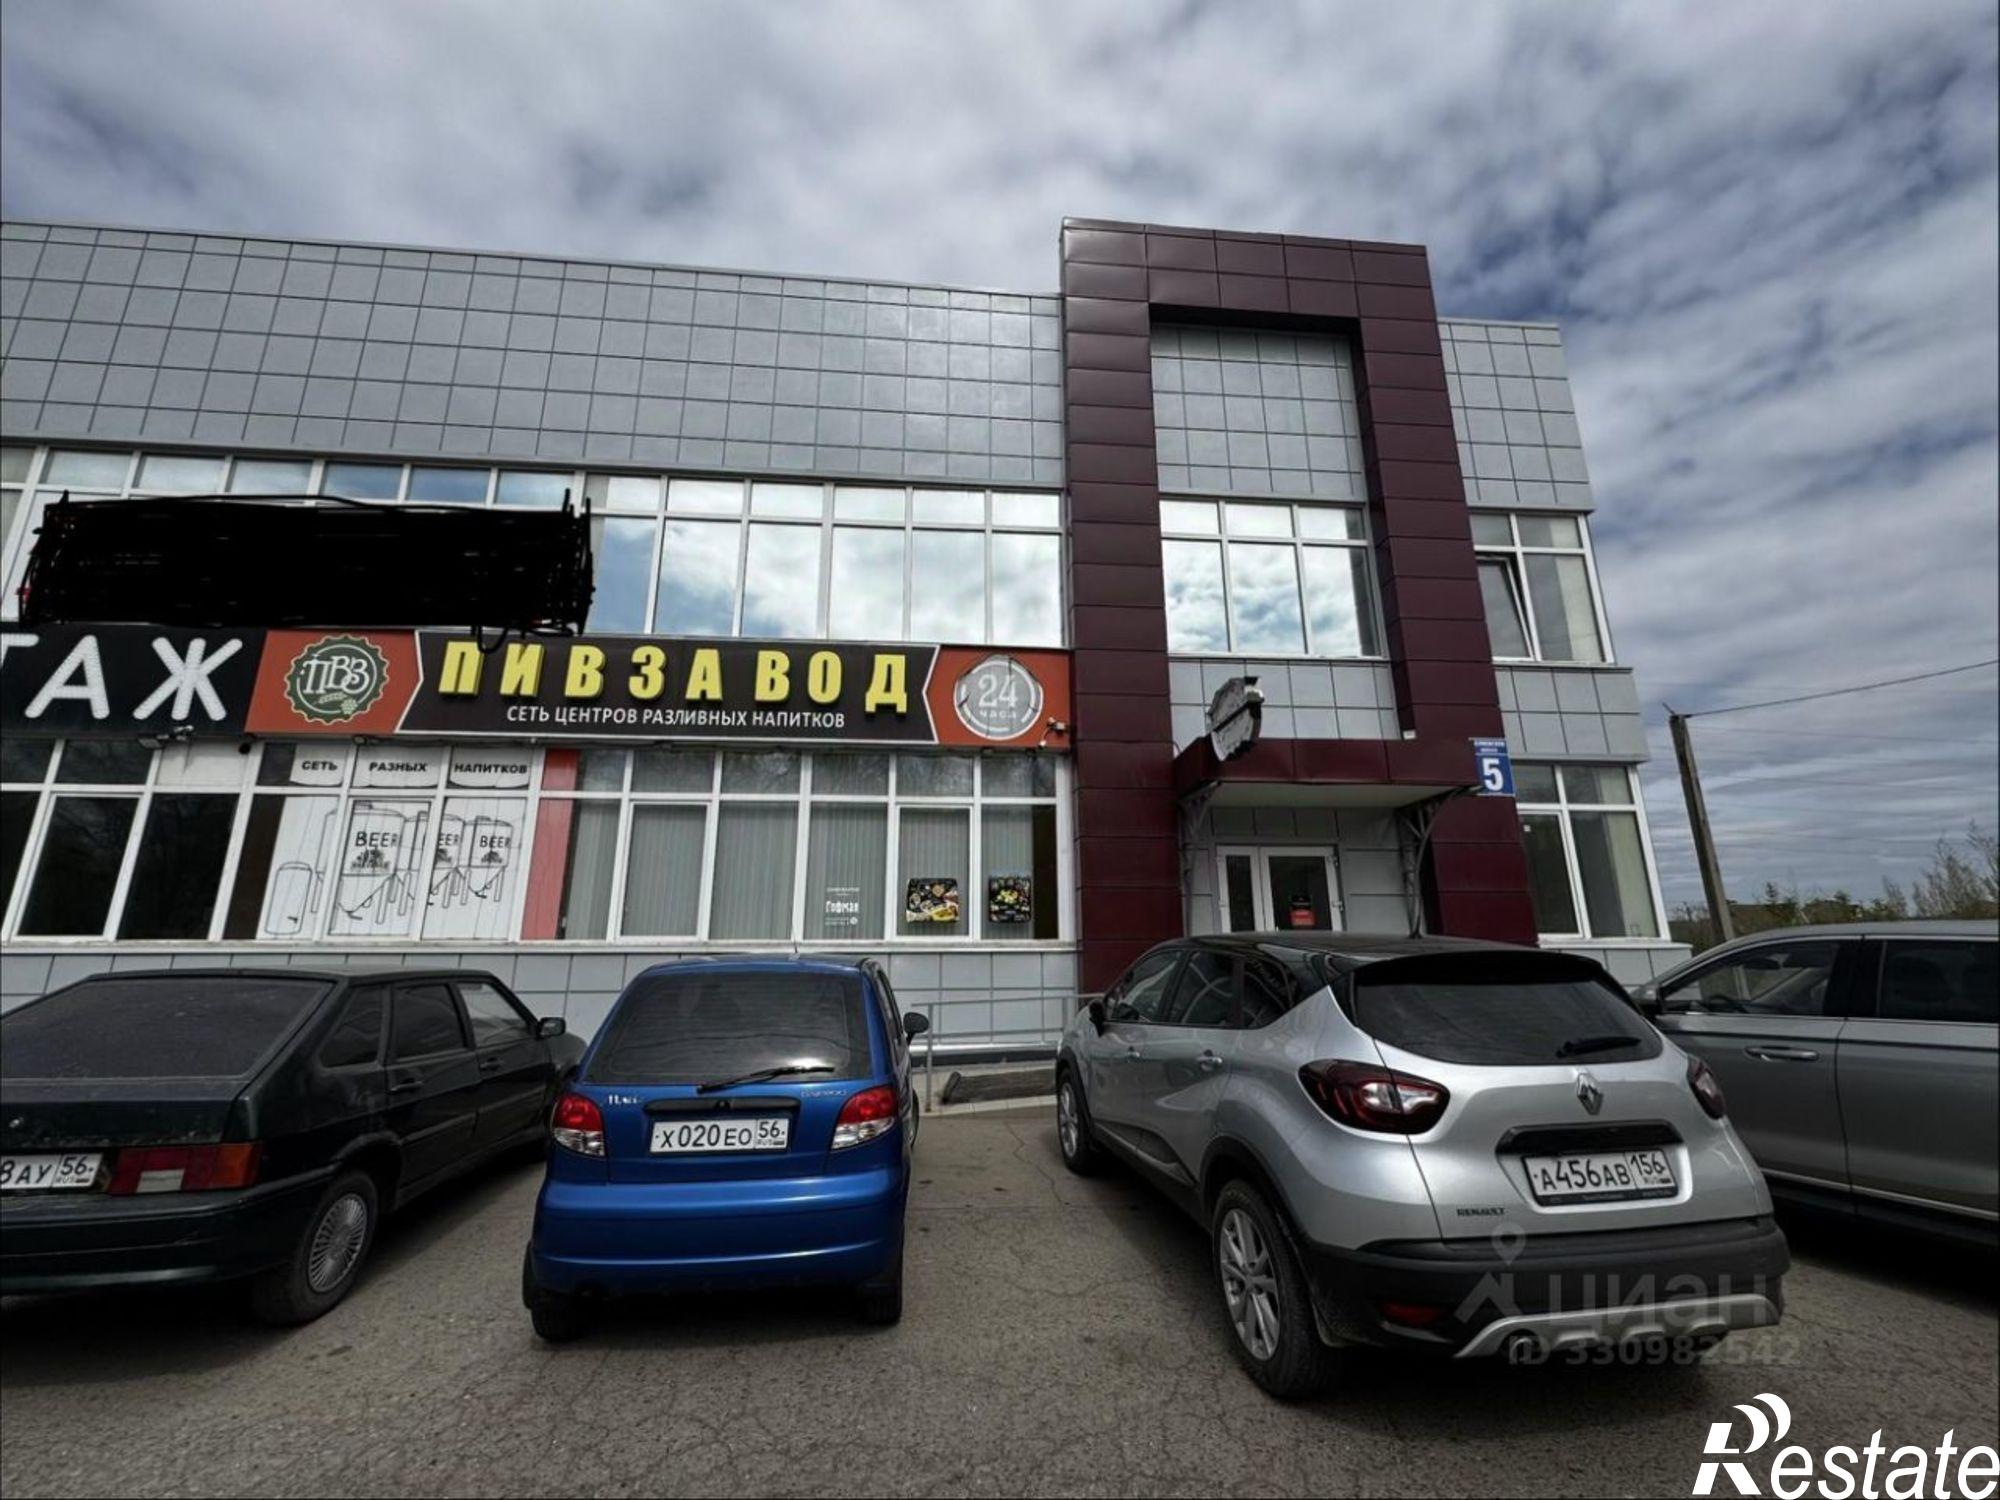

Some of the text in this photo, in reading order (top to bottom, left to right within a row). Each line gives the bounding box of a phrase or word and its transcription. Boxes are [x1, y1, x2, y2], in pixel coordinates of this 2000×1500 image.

[303, 654, 370, 695] ПВЗ
[438, 640, 908, 716] ПИВЗАВОД
[978, 673, 1018, 708] 24
[506, 705, 845, 728] СЕТЬ ЦЕНТРОВ РАЗЛИВНЫХ НАПИТКОВ
[301, 760, 527, 775] СЕТЬ РАЗНЫХ НАПИТКОВ
[1482, 757, 1504, 792] 5
[758, 1120, 779, 1139] 56
[60, 1155, 88, 1176] 56
[1630, 1153, 1664, 1176] 156
